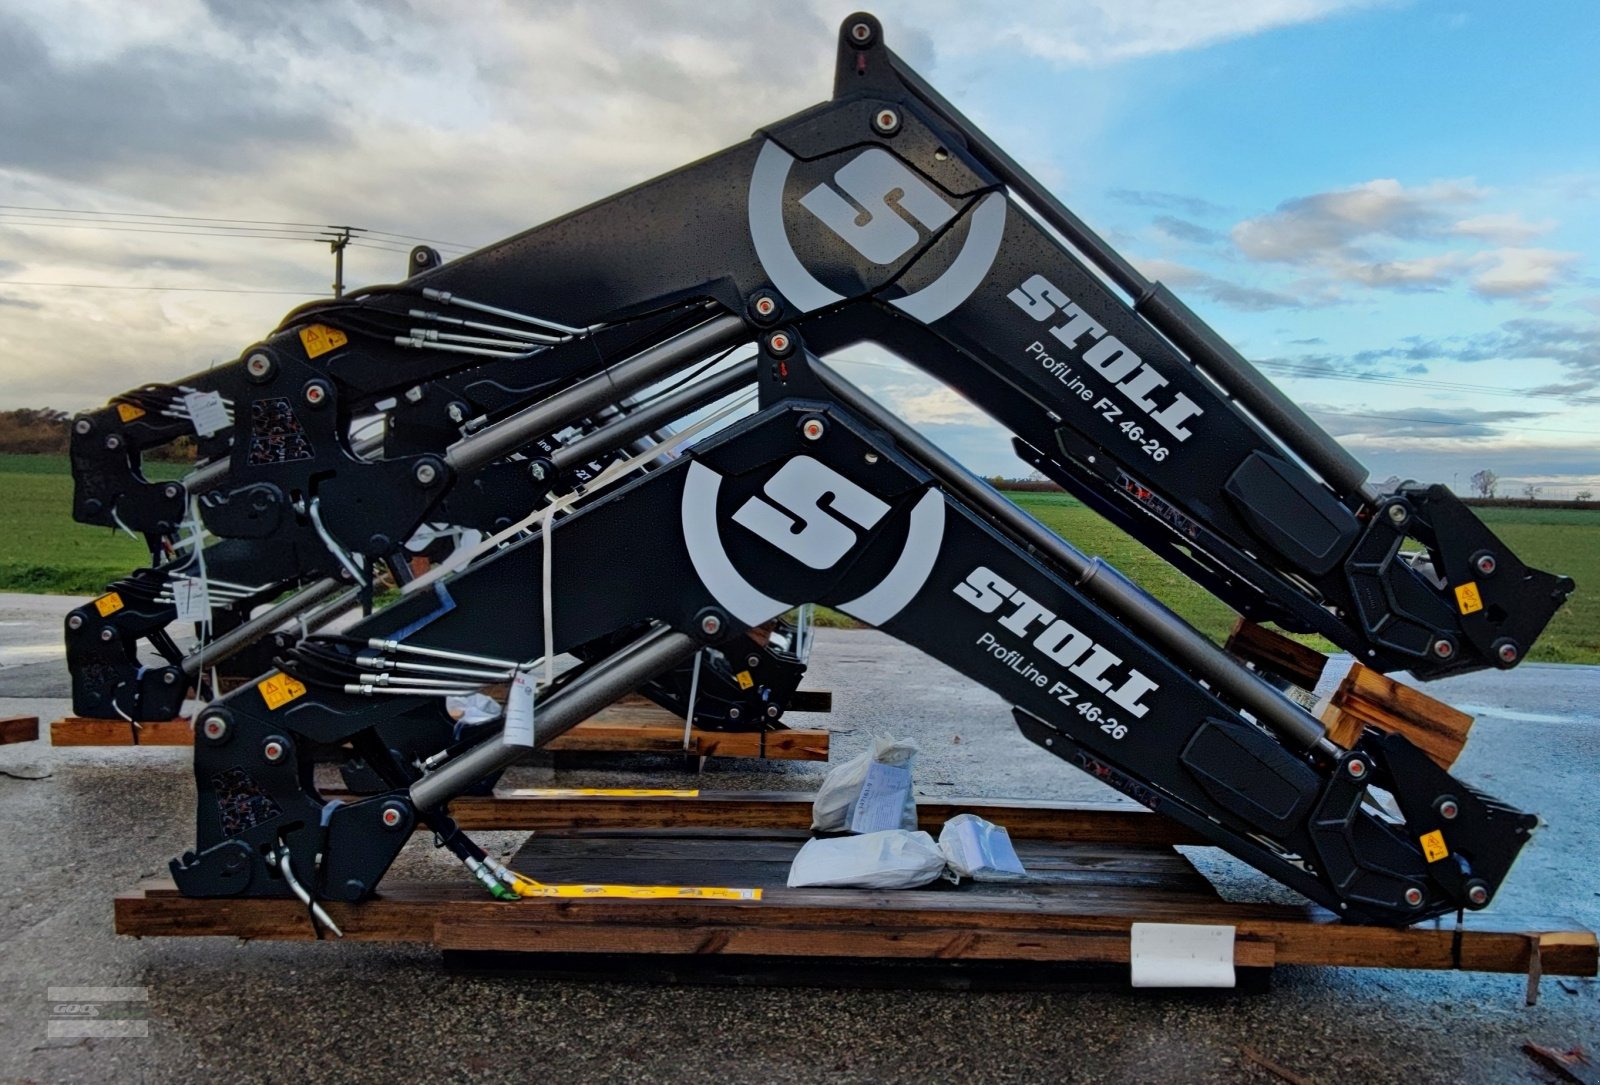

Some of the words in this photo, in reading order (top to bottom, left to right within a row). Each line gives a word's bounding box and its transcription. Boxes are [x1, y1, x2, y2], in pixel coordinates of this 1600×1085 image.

[798, 149, 958, 265] S
[1007, 274, 1203, 441] STOLL
[1025, 341, 1094, 402] ProfiLine
[1093, 397, 1124, 424] FZ
[1119, 421, 1170, 462] 46-26
[731, 455, 892, 570] S
[953, 566, 1159, 718] STOLL
[976, 632, 1049, 688] ProfiLine
[1048, 681, 1080, 706] FZ
[1076, 701, 1129, 740] 46-26
